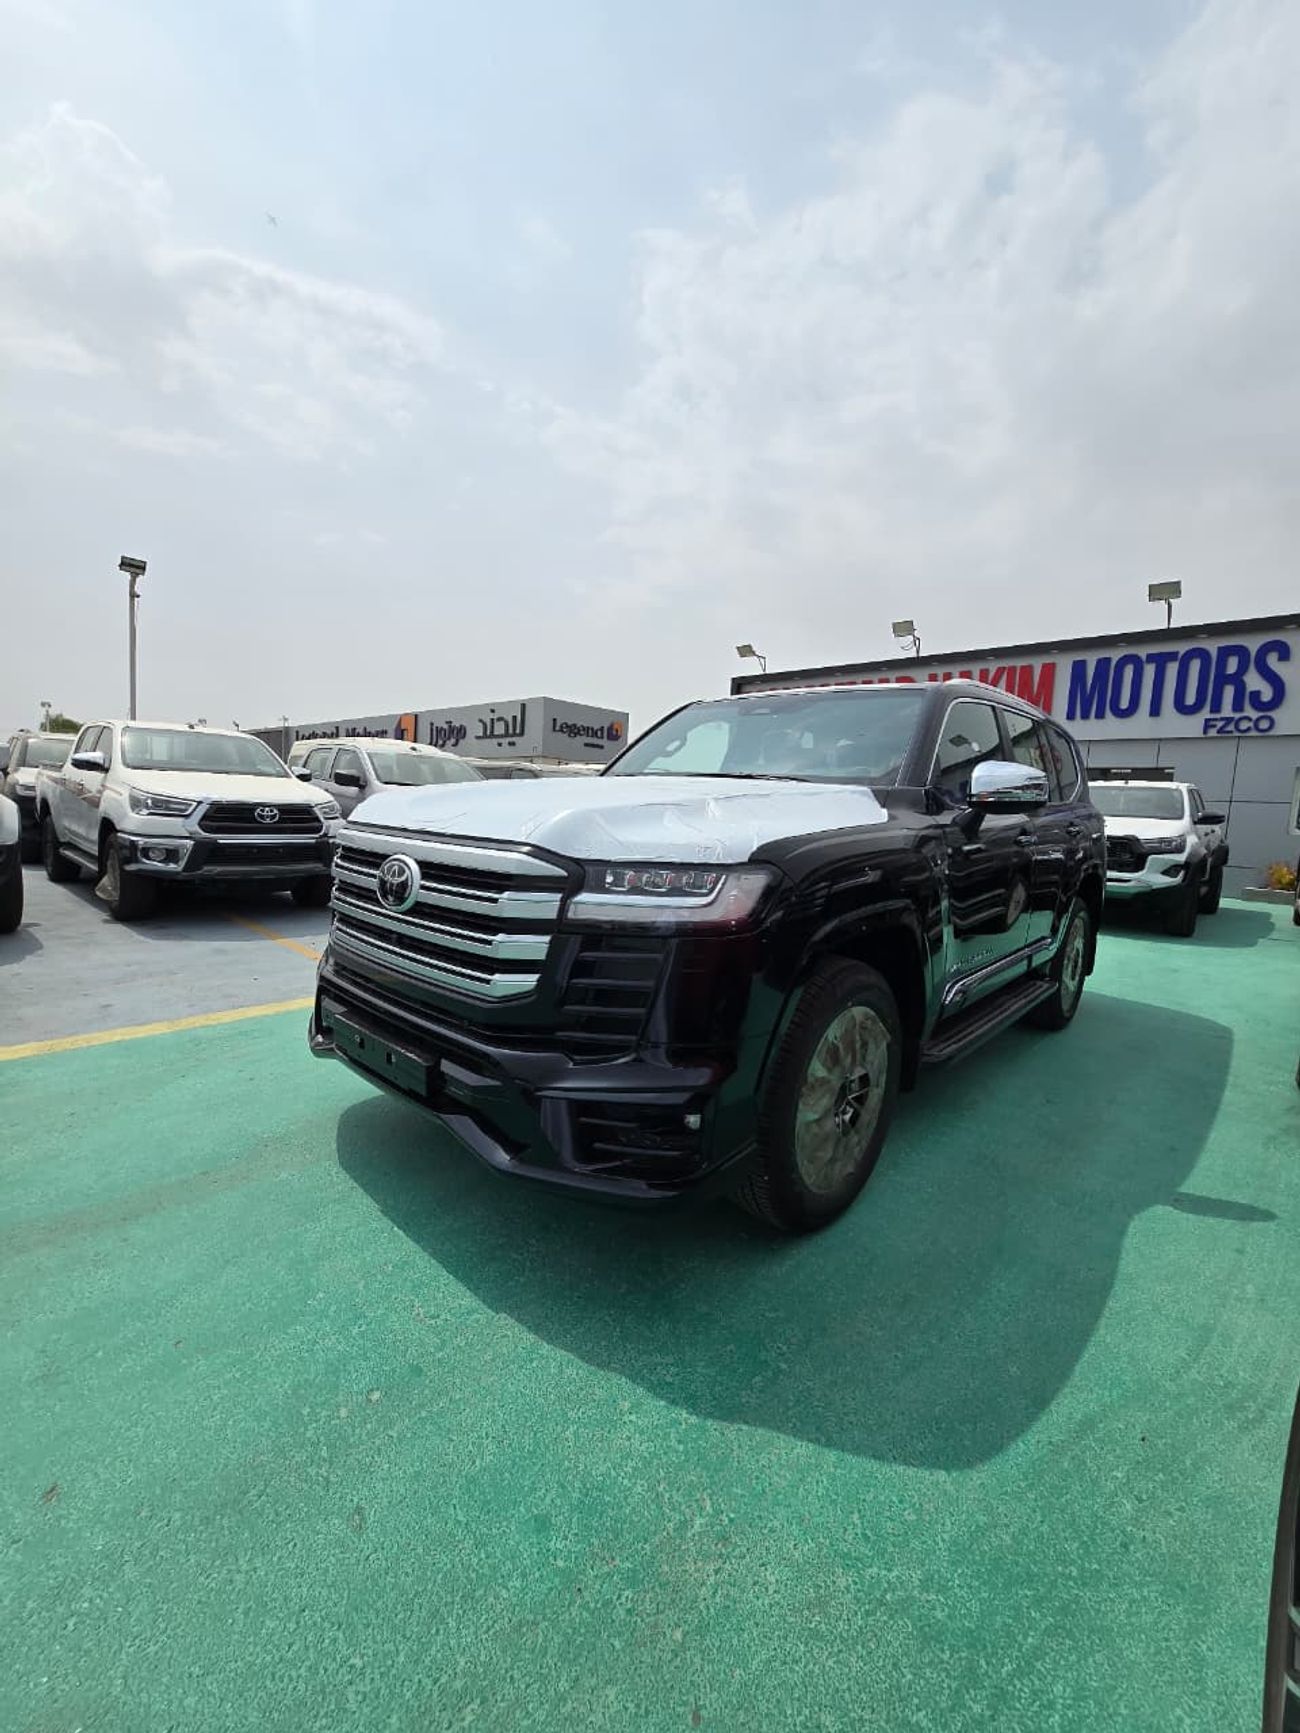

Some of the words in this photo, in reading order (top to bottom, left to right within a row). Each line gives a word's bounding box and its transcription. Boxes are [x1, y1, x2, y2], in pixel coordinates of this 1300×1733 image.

[1066, 639, 1290, 720] MOTORS
[474, 703, 526, 747] ليجند
[552, 718, 605, 740] Legend
[1203, 715, 1276, 735] FZCO
